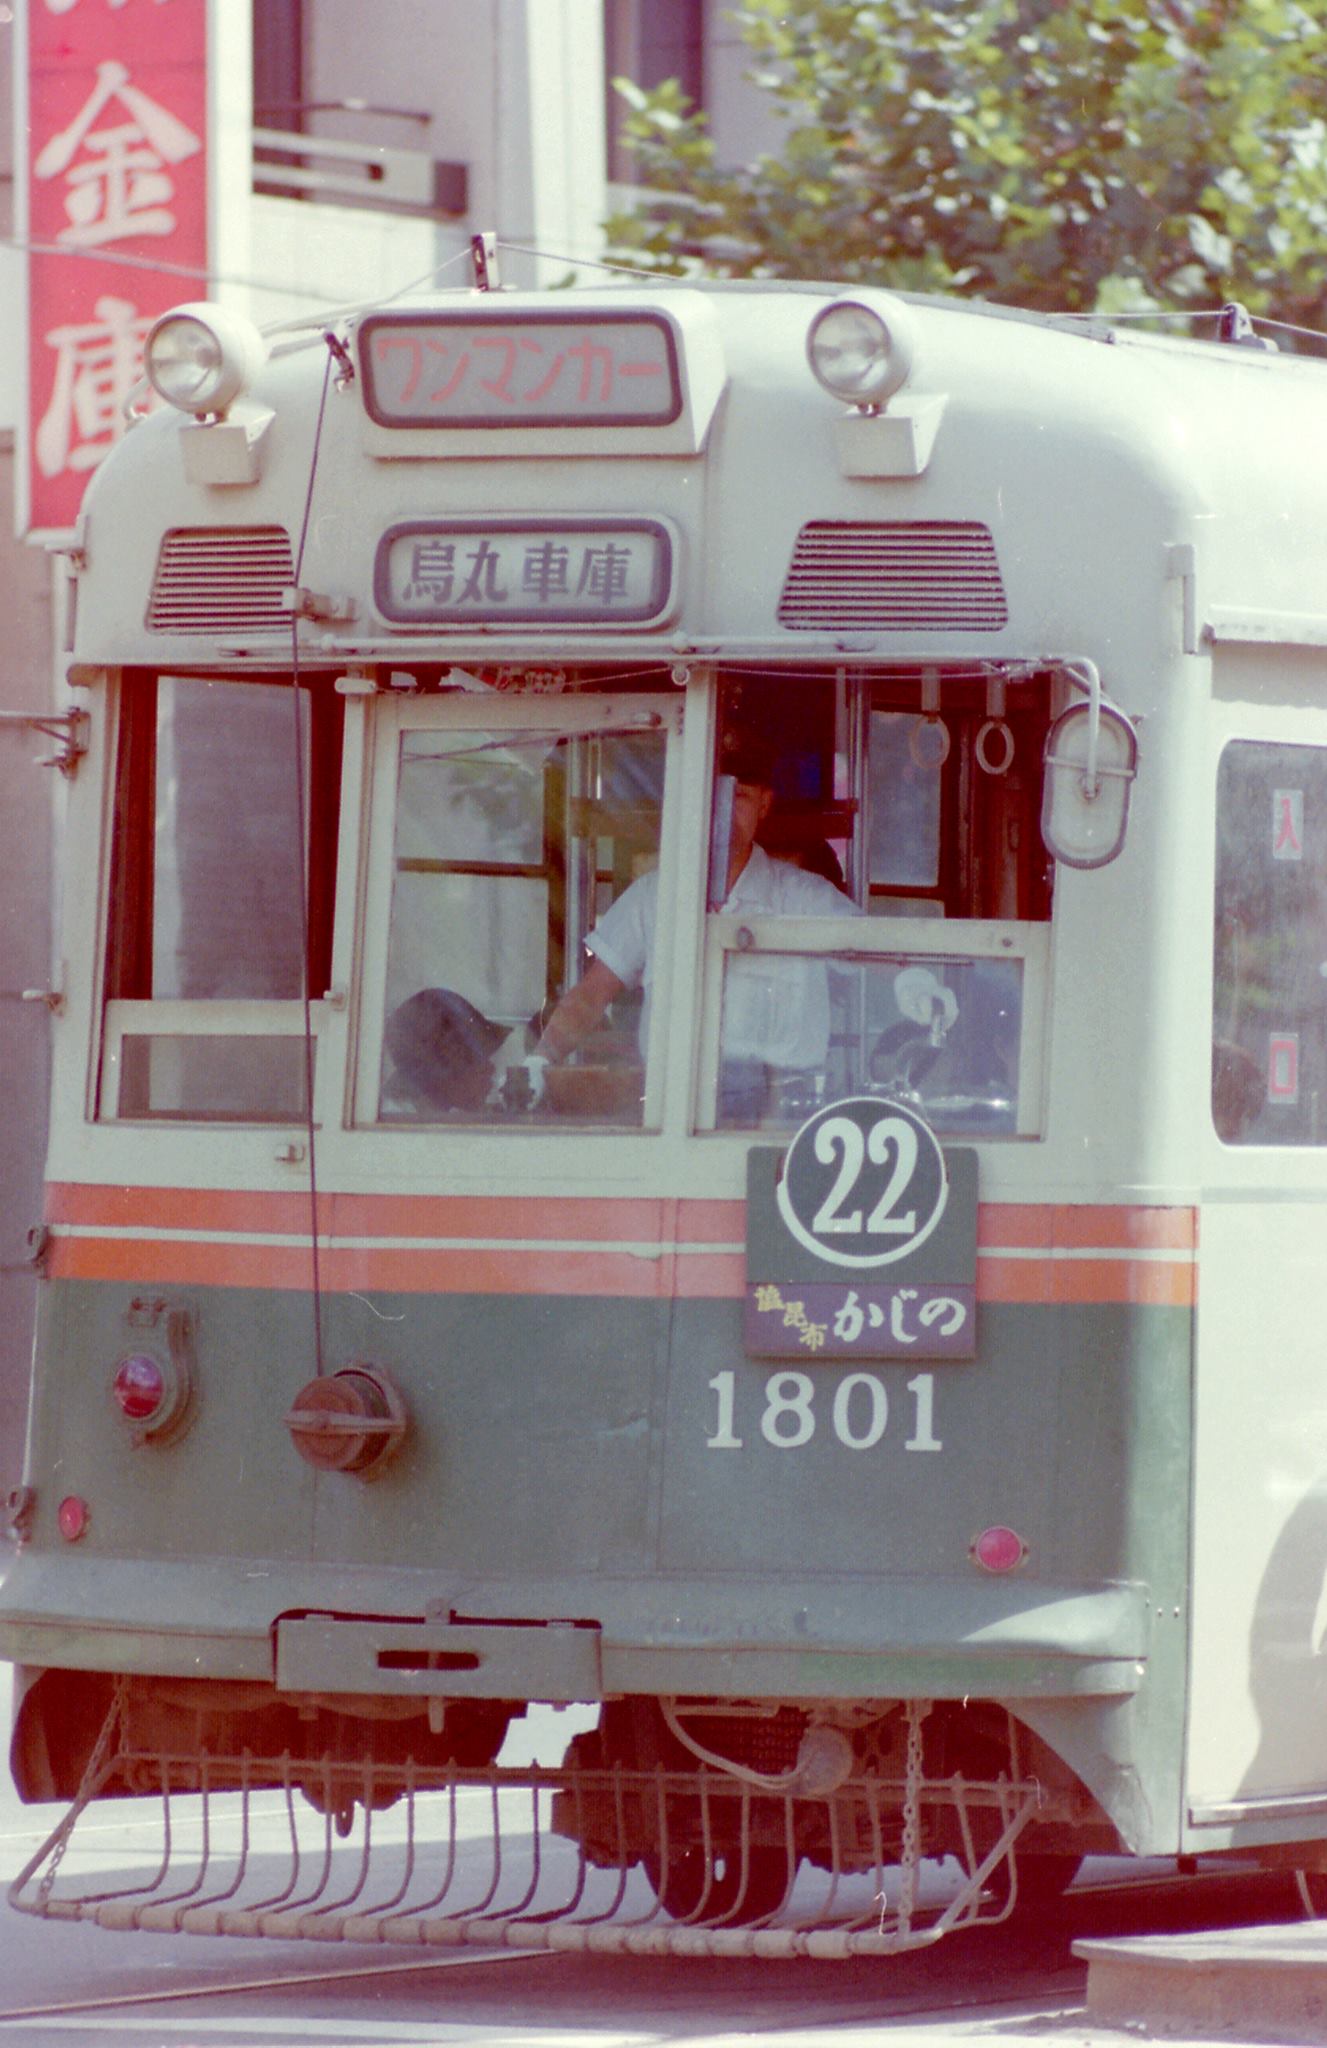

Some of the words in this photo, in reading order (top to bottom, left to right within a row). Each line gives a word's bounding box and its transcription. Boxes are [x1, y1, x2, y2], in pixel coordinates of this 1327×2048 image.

[34, 0, 201, 478] 金庫
[376, 335, 664, 405] ワンマンカー
[812, 1116, 919, 1234] 22
[834, 1290, 967, 1343] かじの
[707, 1370, 943, 1451] 1801
